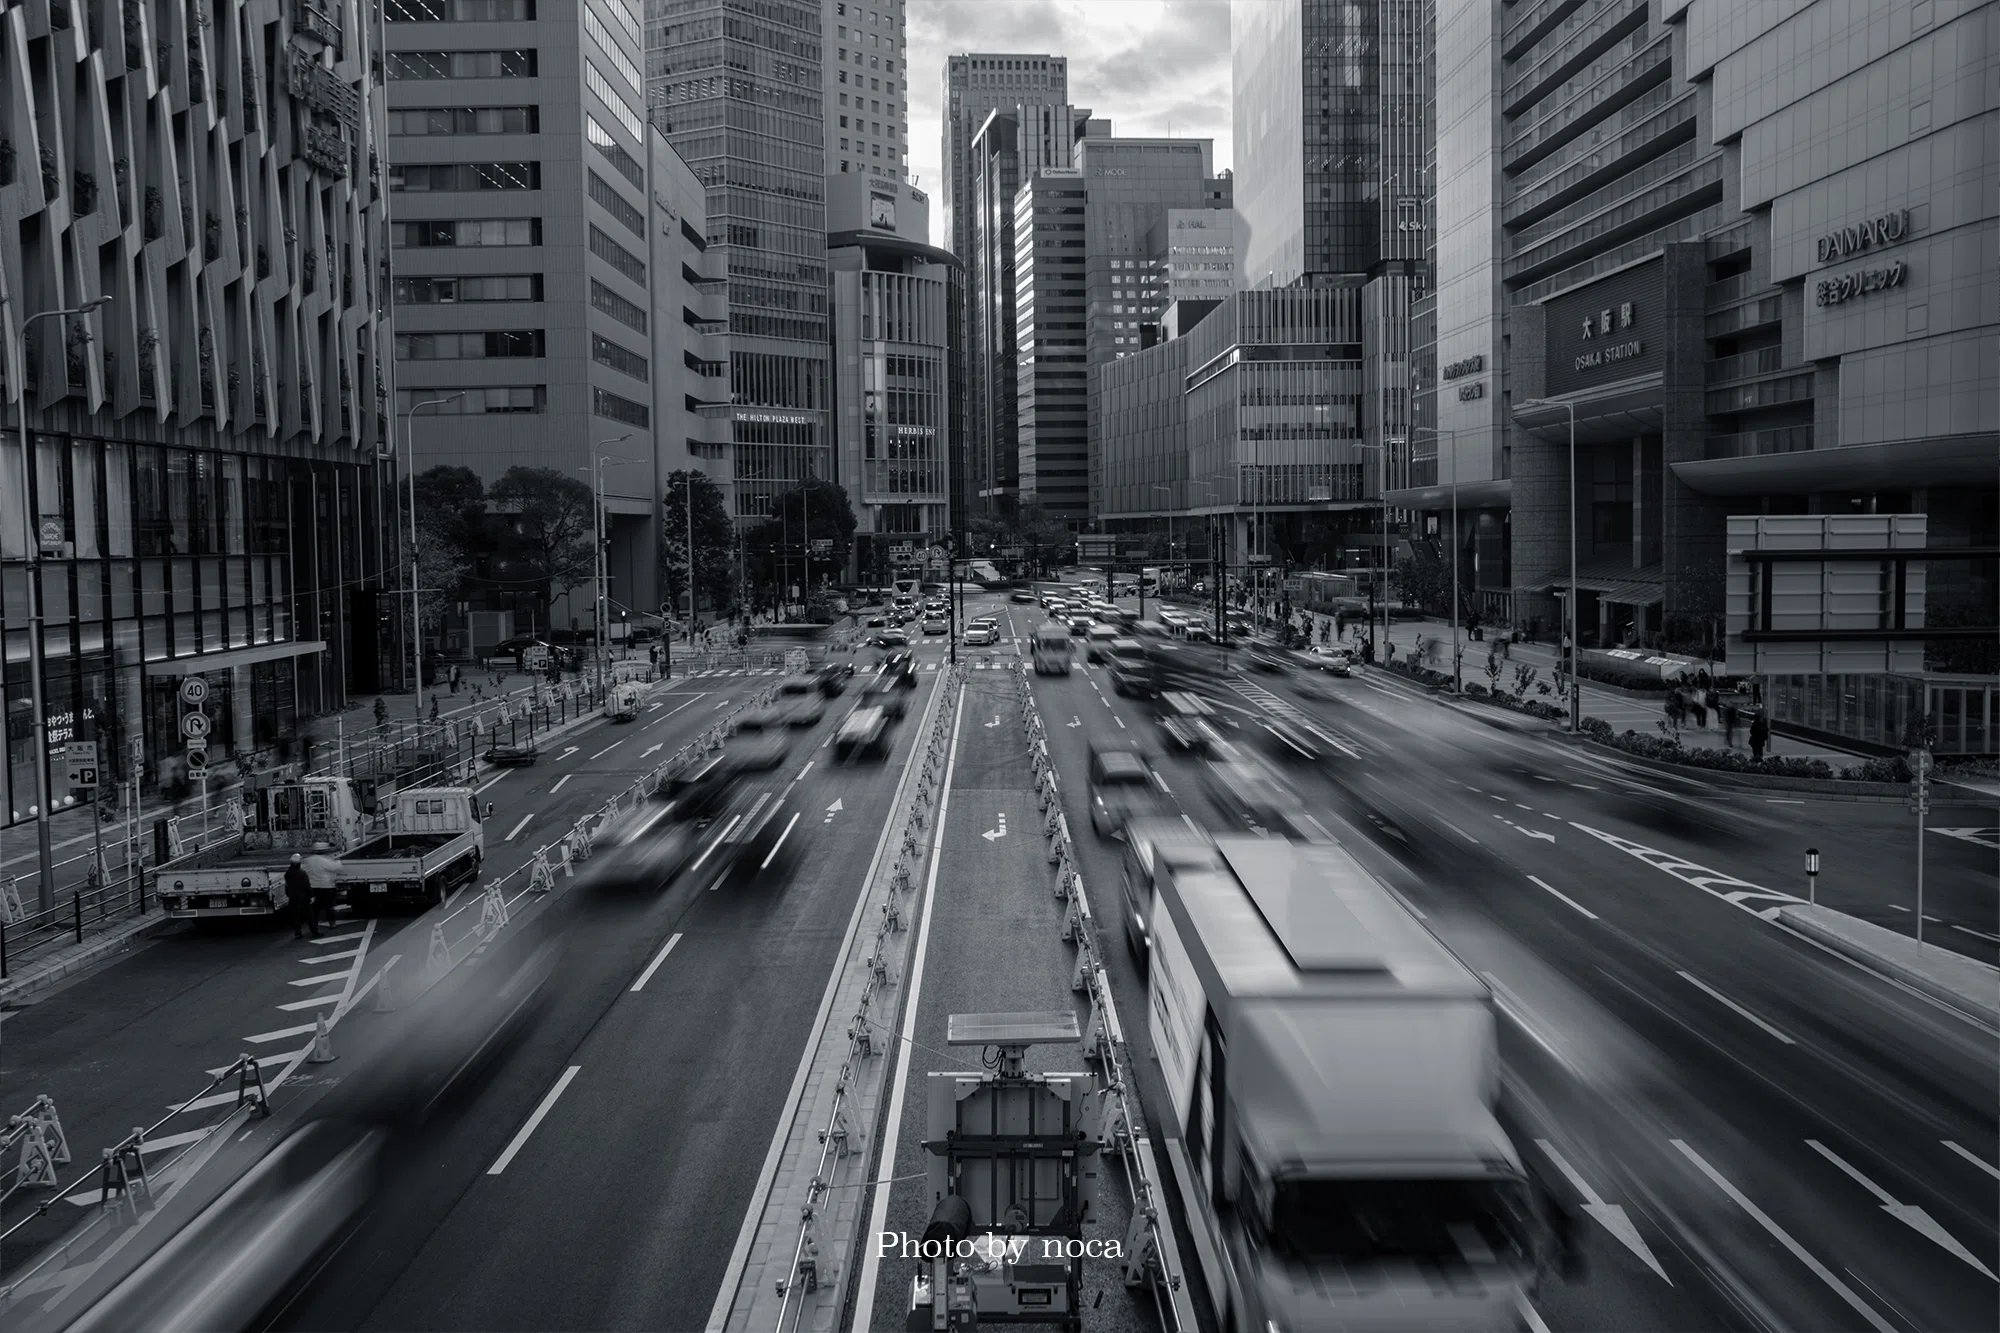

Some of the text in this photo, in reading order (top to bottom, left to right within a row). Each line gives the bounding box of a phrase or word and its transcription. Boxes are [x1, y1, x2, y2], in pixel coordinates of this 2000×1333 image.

[1817, 209, 1909, 262] DAIMARU
[1816, 261, 1907, 307] 総合クリニック
[1582, 302, 1634, 340] 大阪駅
[1575, 341, 1641, 371] OSAKA STATION
[736, 413, 804, 424] THE HILTON PLAZA WEST
[898, 427, 924, 436] HERBIS
[187, 684, 203, 697] 40
